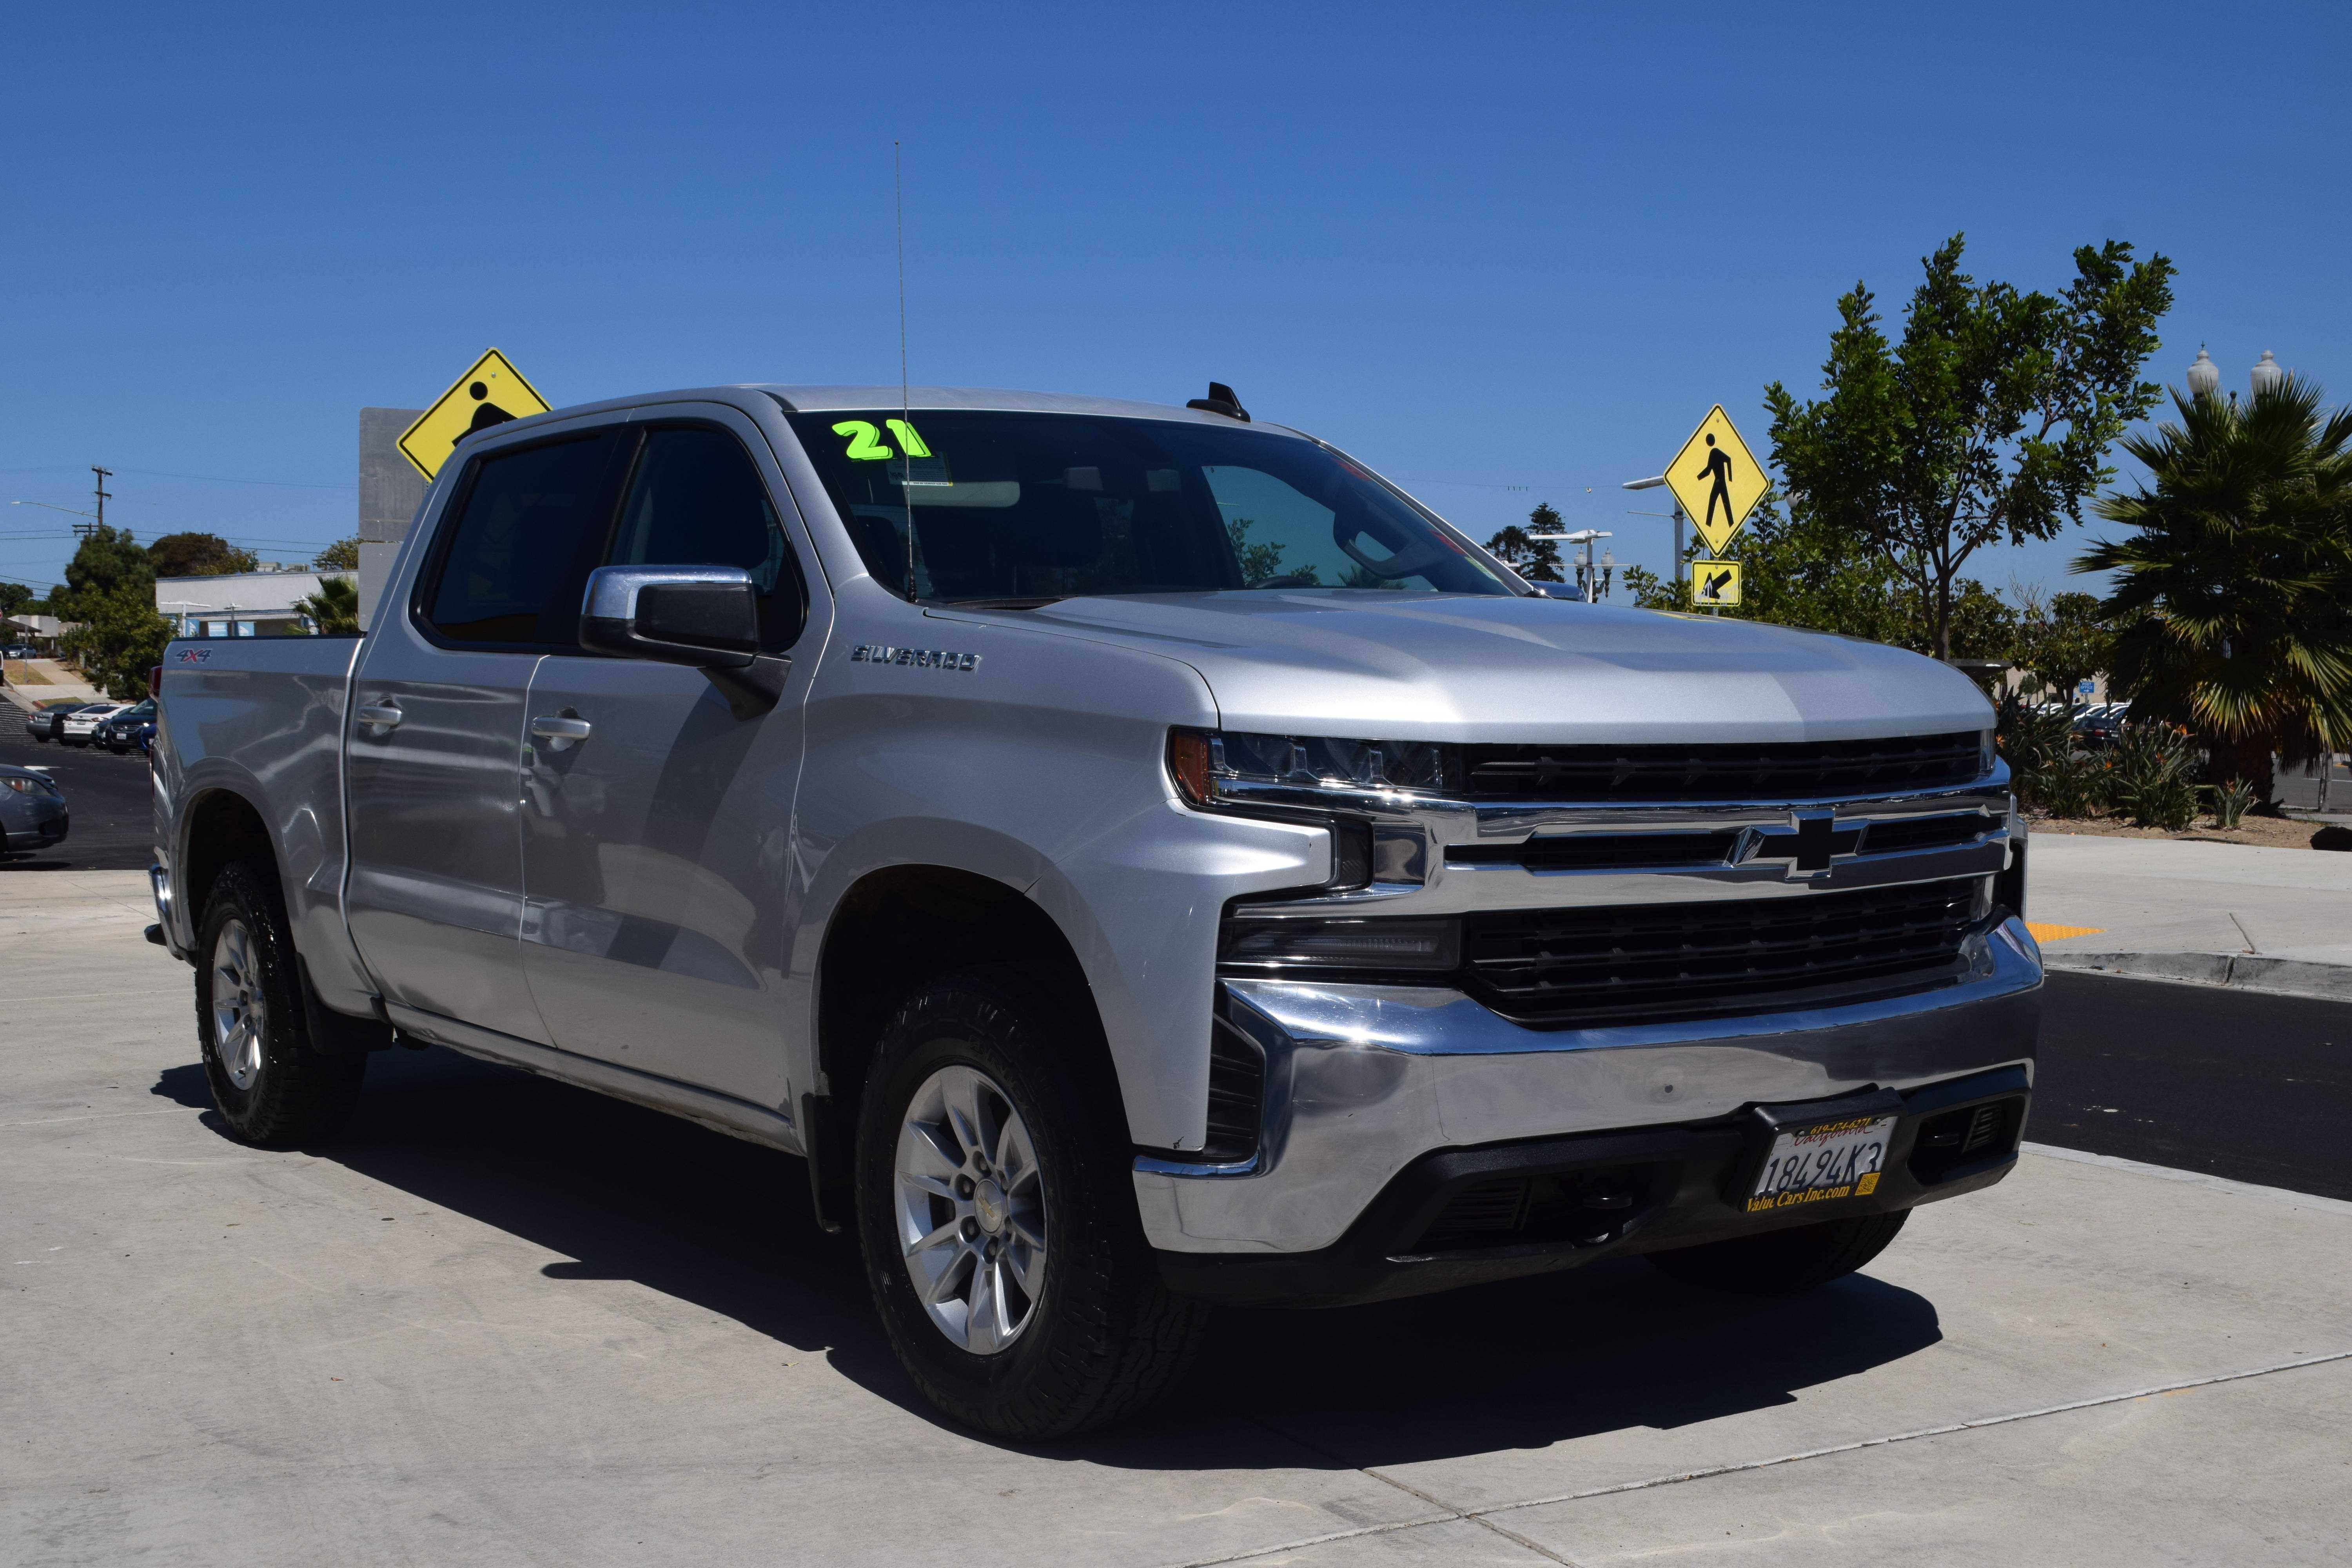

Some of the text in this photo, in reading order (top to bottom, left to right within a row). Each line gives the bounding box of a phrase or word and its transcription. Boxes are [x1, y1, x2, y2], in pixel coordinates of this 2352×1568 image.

[831, 419, 932, 460] 21
[851, 645, 981, 671] SILVERADO
[1810, 1117, 1872, 1135] 619-474-6271
